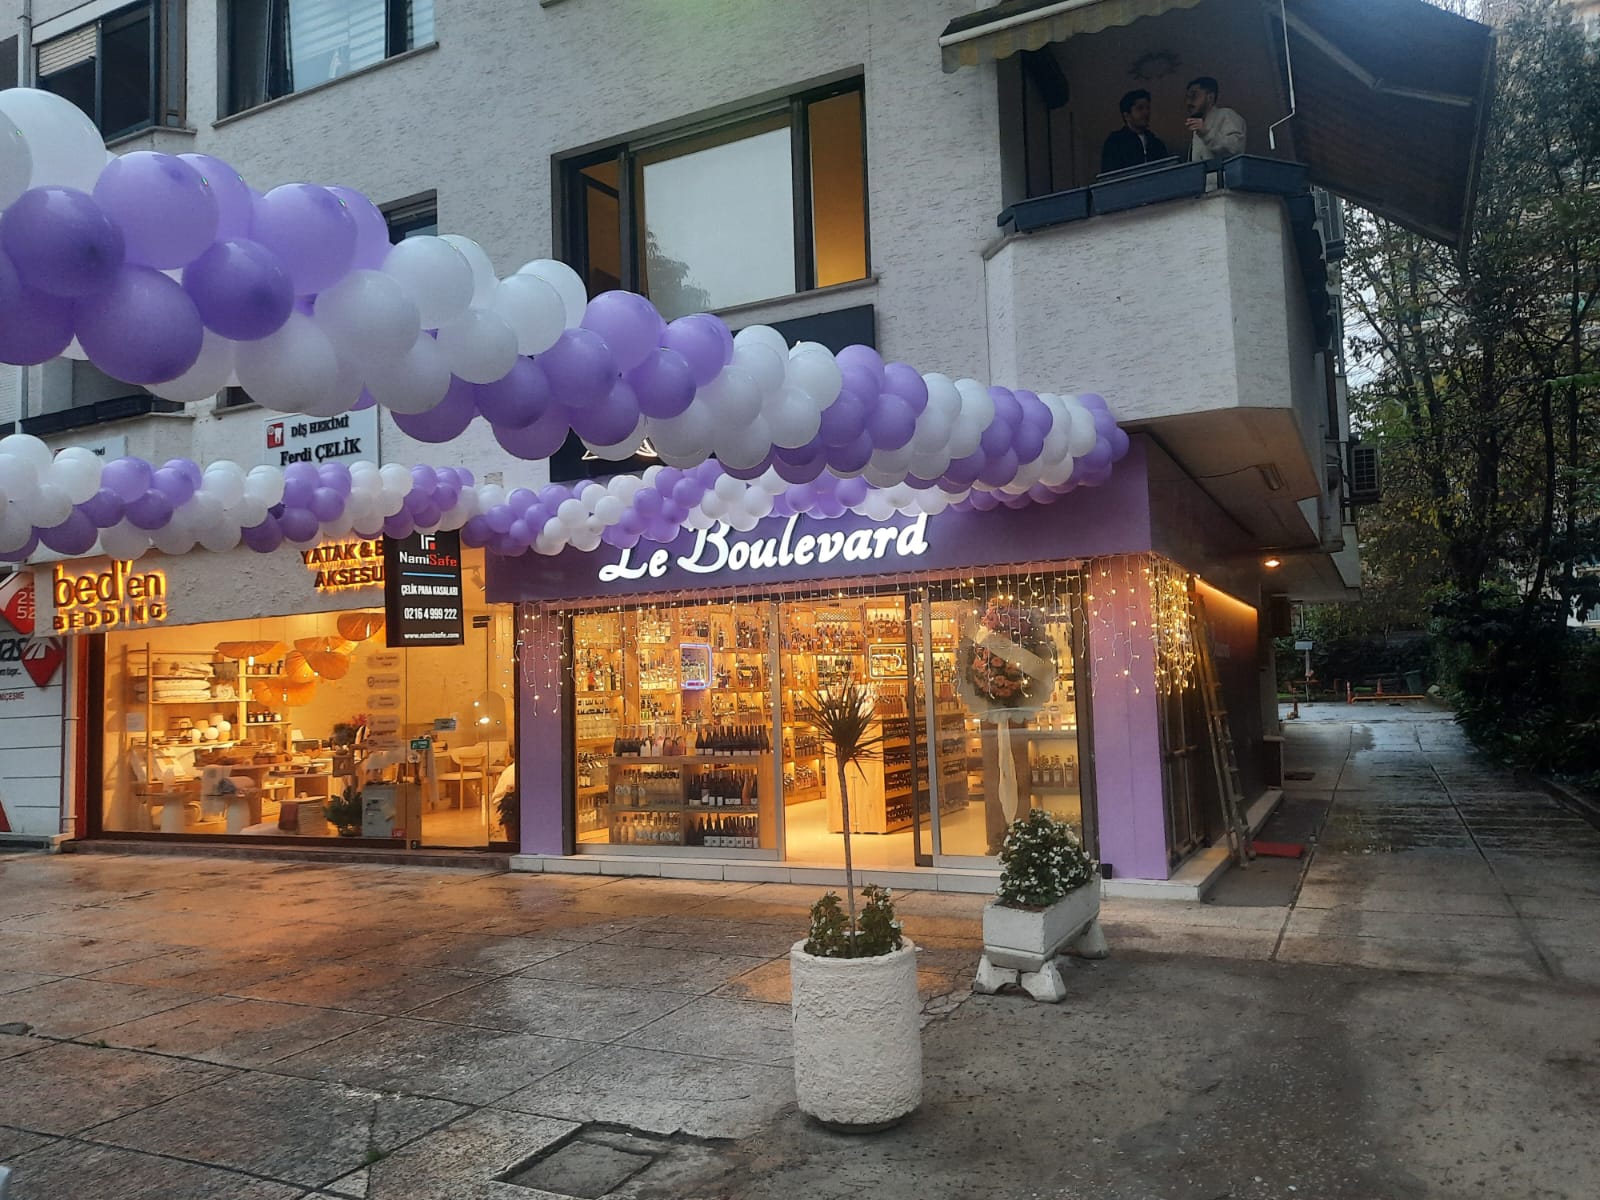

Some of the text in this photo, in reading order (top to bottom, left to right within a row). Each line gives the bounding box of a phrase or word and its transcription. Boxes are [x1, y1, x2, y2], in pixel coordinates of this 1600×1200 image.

[291, 414, 350, 438] DİŞ HEKİMİ
[280, 437, 361, 466] Ferdi ÇELİK
[301, 543, 358, 565] YATAK
[360, 541, 373, 558] &
[399, 551, 458, 566] NamiSafe
[598, 512, 929, 582] Le Boulevard
[53, 603, 162, 629] BEDDING
[404, 607, 458, 620] 0216 4 999 222
